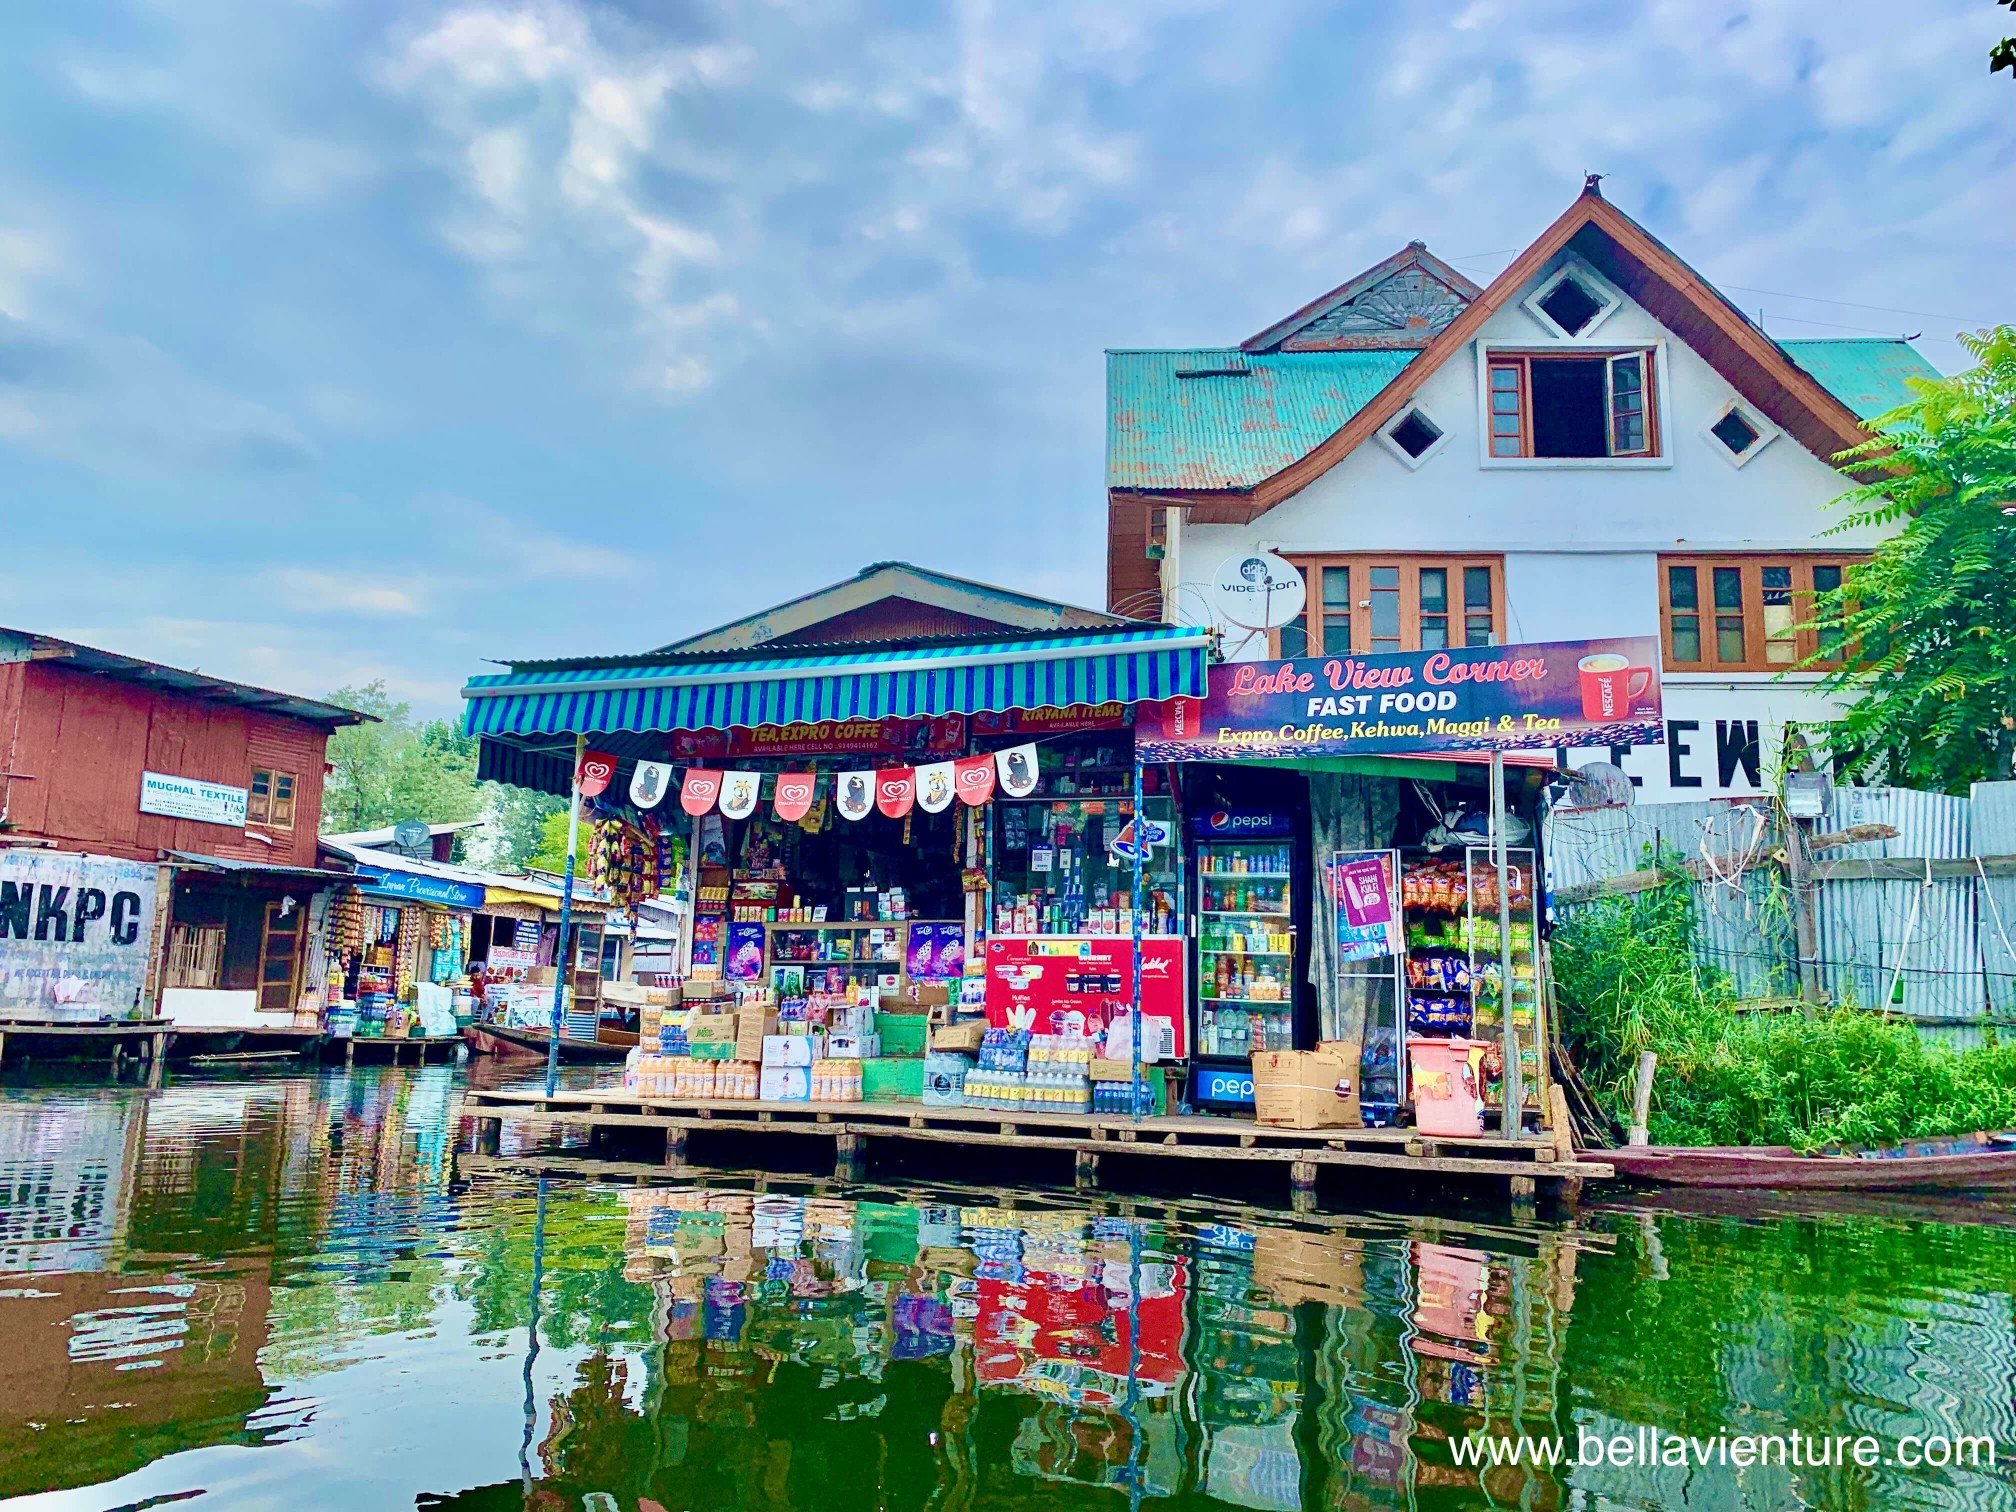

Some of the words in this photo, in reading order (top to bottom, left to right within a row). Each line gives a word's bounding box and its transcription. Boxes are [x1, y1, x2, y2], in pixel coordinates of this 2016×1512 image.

[1227, 663, 1315, 696] Lake
[1323, 659, 1414, 691] View
[1423, 653, 1548, 685] Corner
[1082, 704, 1123, 717] ITEMS
[1307, 695, 1372, 717] FAST
[1379, 691, 1457, 714] FOOD
[834, 723, 880, 740] COFFE
[1496, 715, 1516, 733] &
[1523, 713, 1561, 732] Tea
[753, 745, 788, 753] AVAILABLE
[806, 743, 821, 751] CELL
[147, 780, 196, 796] MUGHAL
[199, 789, 244, 804] TEXTILE
[1232, 813, 1272, 829] pepsi
[0, 881, 141, 945] NKPC
[1211, 1078, 1255, 1099] pep
